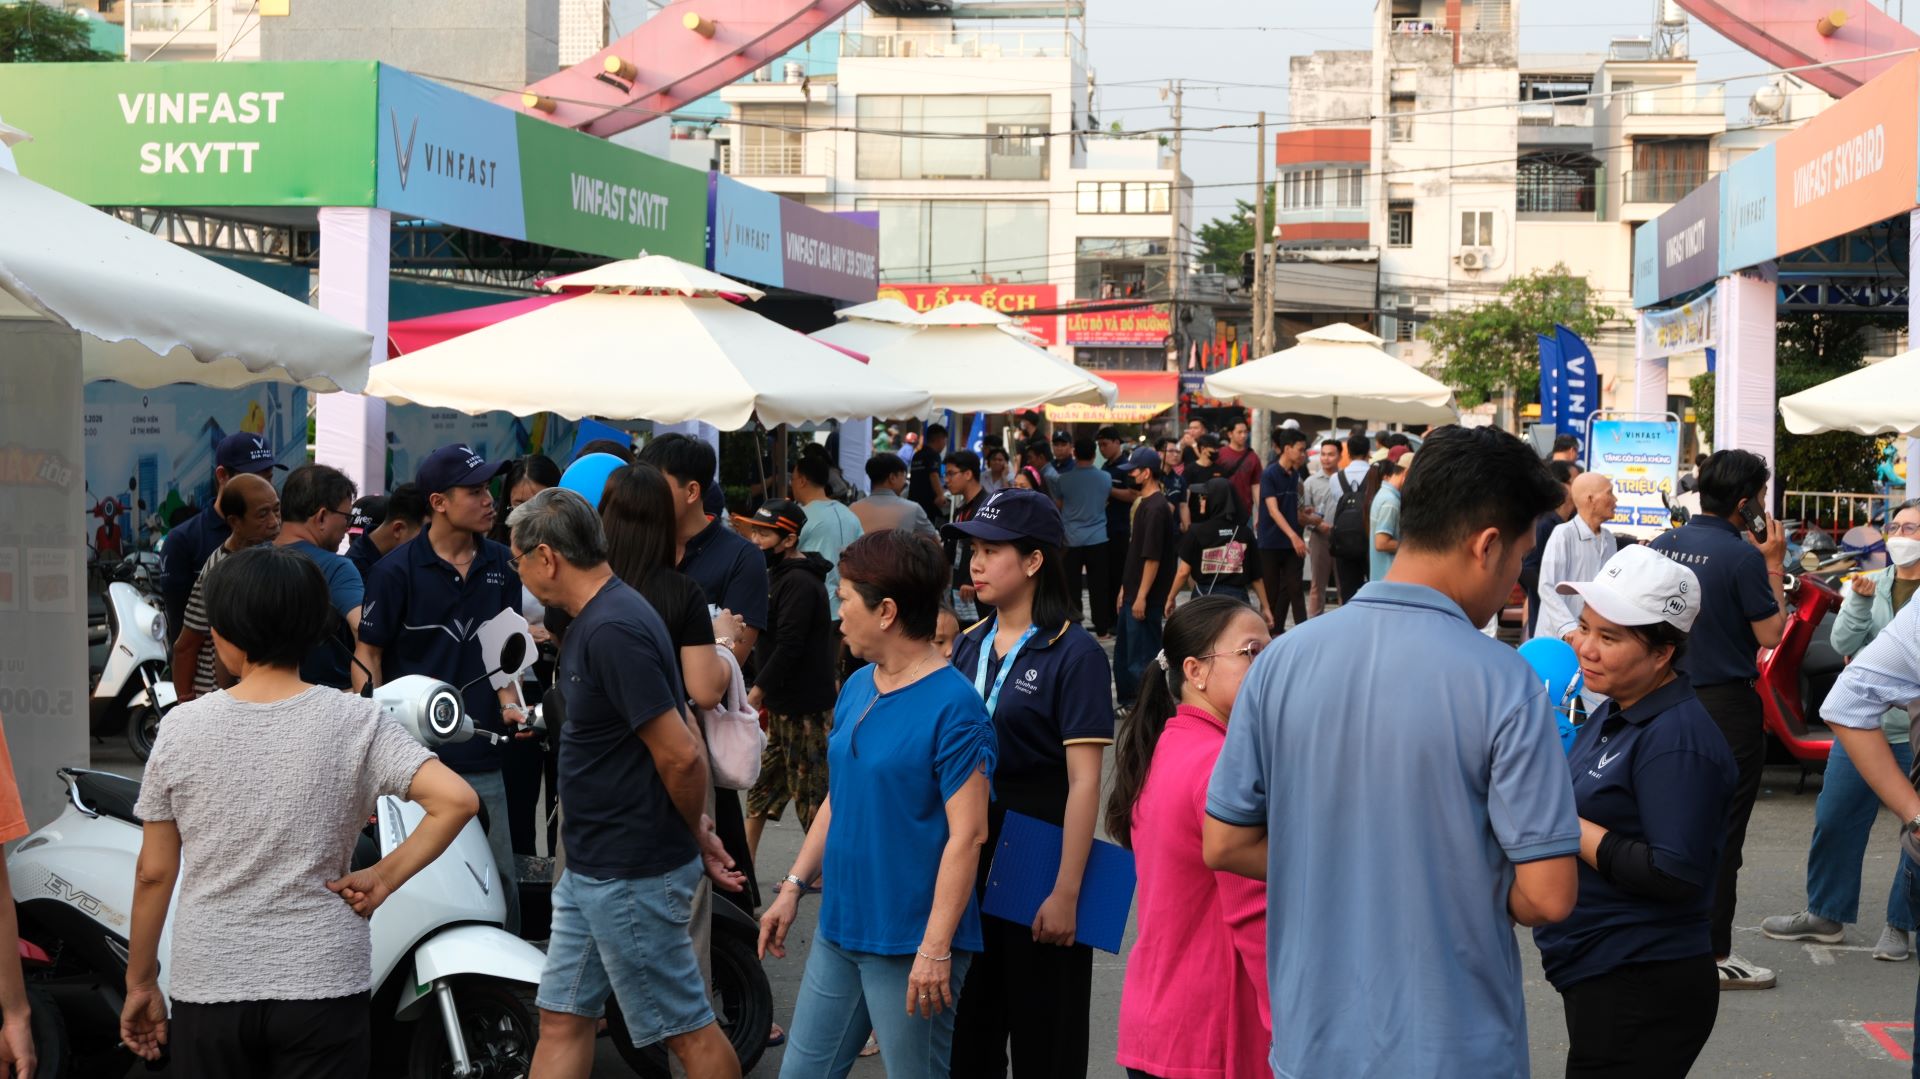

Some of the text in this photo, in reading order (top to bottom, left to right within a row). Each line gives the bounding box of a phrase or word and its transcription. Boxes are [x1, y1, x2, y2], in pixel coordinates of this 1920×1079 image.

[118, 91, 285, 125] VINFAST
[139, 141, 261, 175] SKYTT
[425, 143, 497, 188] VINFAST
[1793, 123, 1885, 209] VINFAST SKYBIRD
[570, 172, 669, 231] VINFAST SKYTT
[1740, 196, 1766, 229] VINFAST
[736, 223, 770, 253] VINFAST
[1666, 231, 1685, 269] VINFAST
[786, 231, 818, 267] VINFAST
[818, 241, 831, 269] GIA
[831, 244, 847, 273] HUY
[855, 252, 875, 280] STORE
[981, 287, 1036, 313] ẾCH
[1616, 476, 1657, 496] TRIỆU
[1669, 600, 1683, 612] HI!
[1015, 679, 1038, 691] Shinhan
[44, 872, 102, 916] EVO
